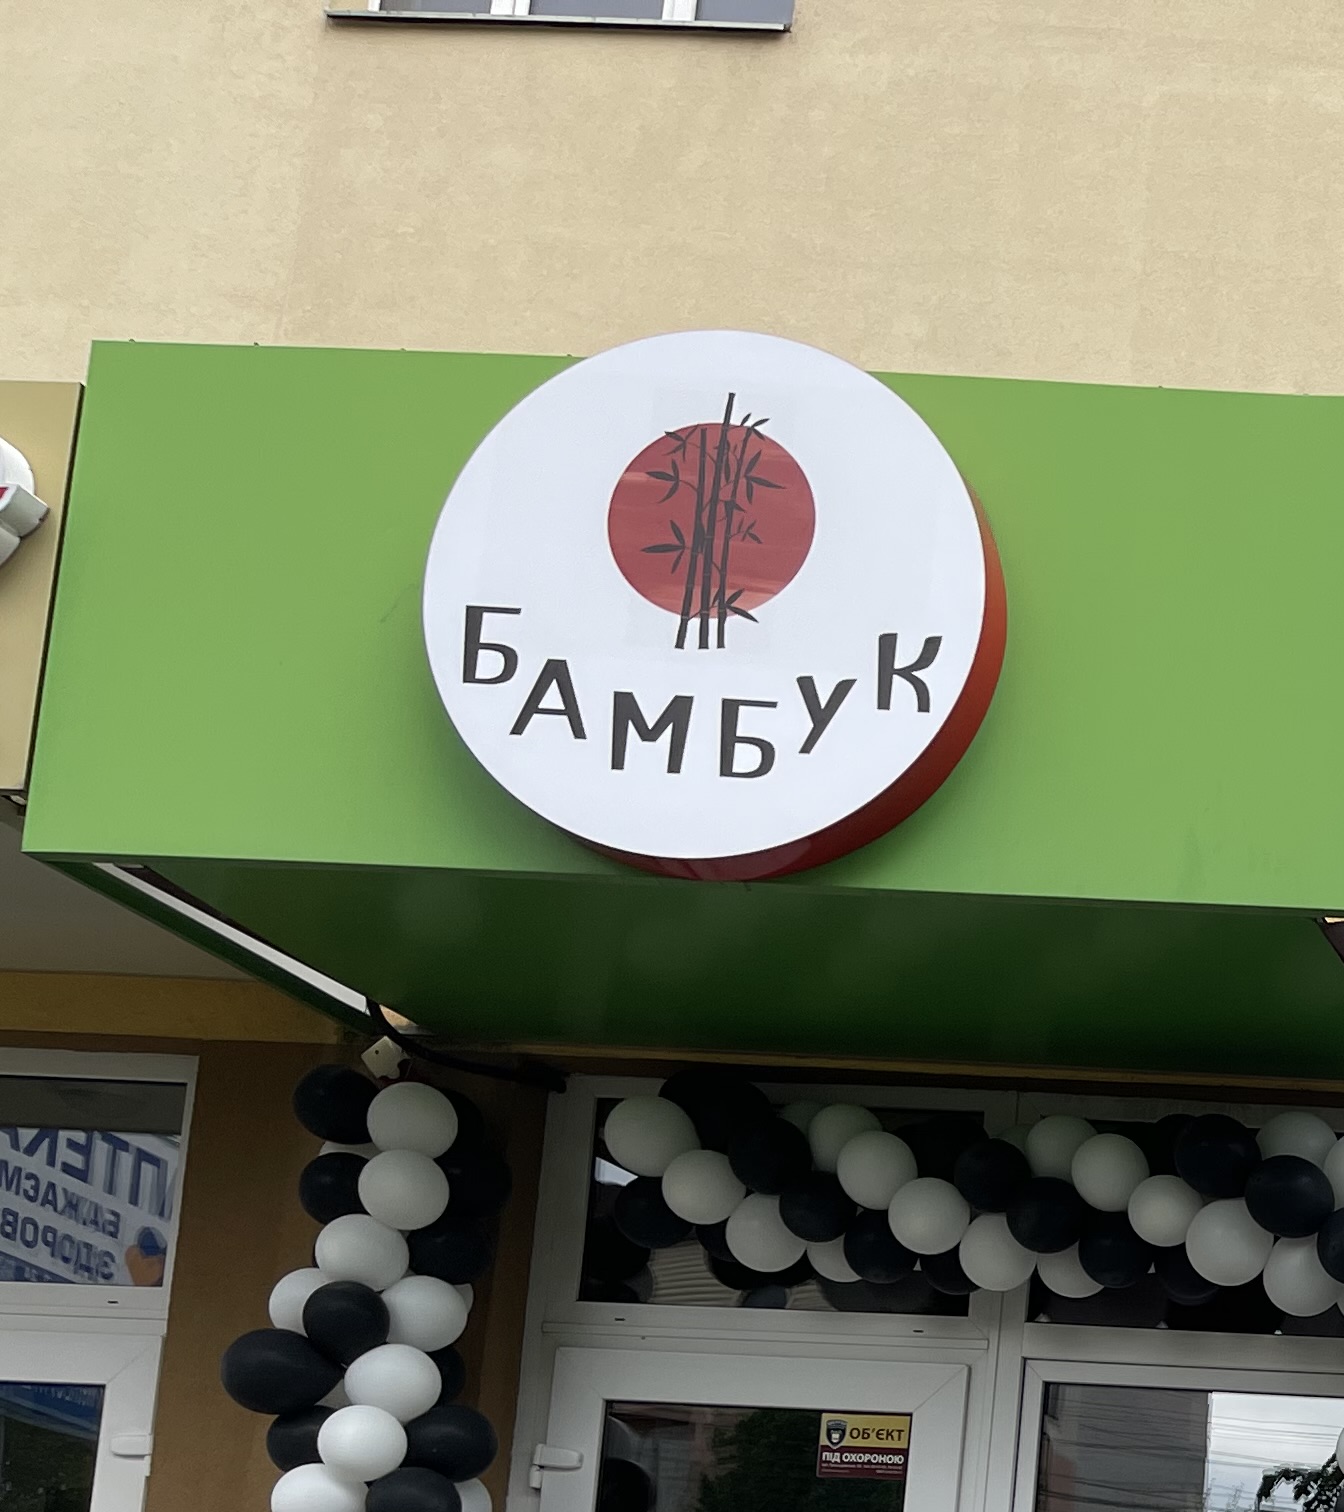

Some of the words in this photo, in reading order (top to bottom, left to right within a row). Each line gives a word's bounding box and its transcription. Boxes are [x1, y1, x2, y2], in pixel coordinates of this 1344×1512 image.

[463, 605, 942, 778] БАМБУК
[822, 1452, 841, 1464] ПІД
[842, 1453, 905, 1465] ОХОРОНОЮ
